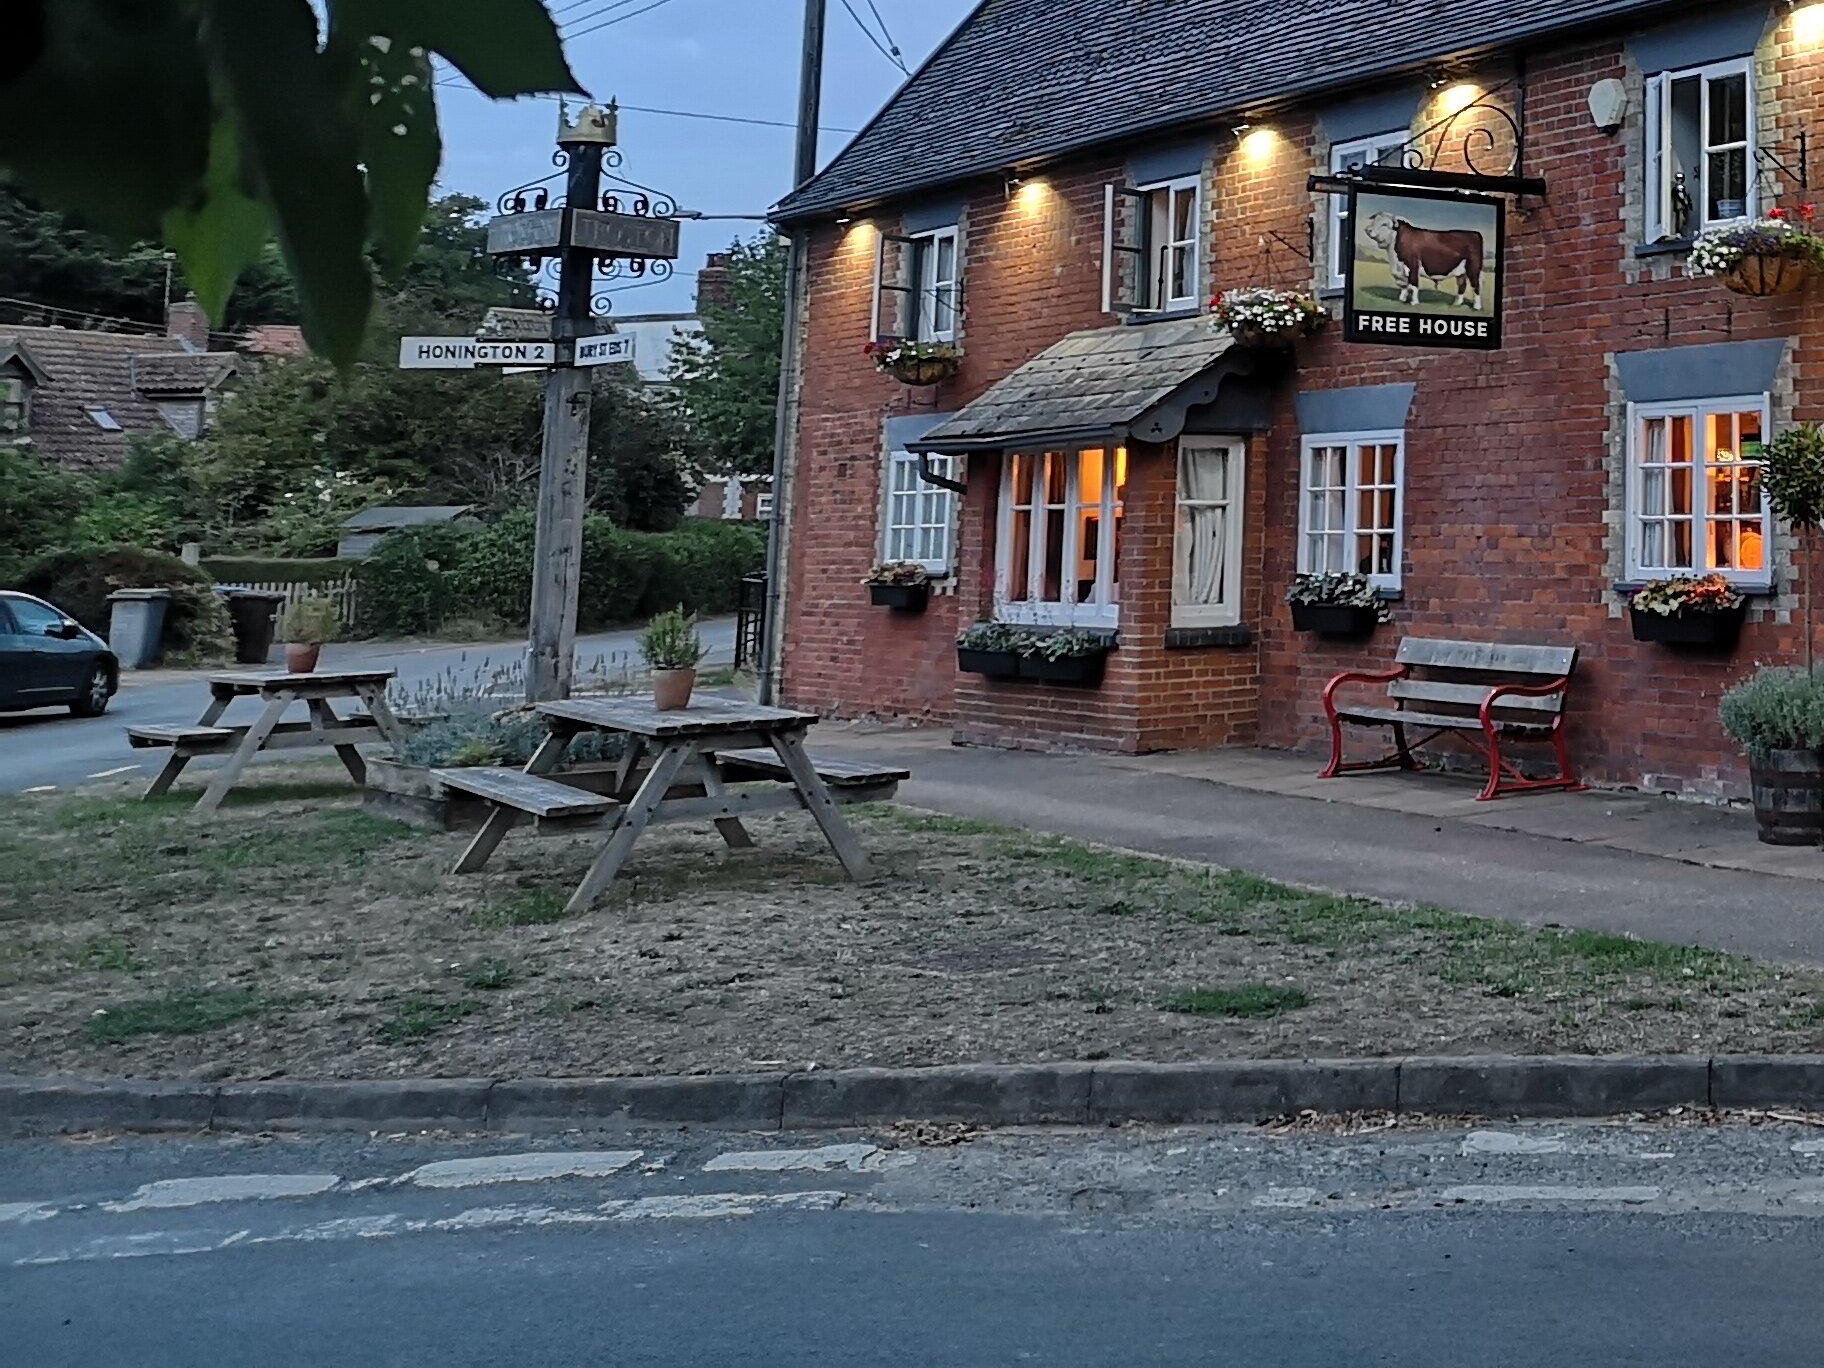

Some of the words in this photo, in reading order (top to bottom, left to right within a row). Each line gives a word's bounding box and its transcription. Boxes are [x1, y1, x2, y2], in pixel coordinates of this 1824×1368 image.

[1358, 315, 1411, 333] FREE
[1419, 318, 1488, 337] HOUSE
[418, 344, 527, 359] HONINGTON
[534, 345, 545, 359] 2
